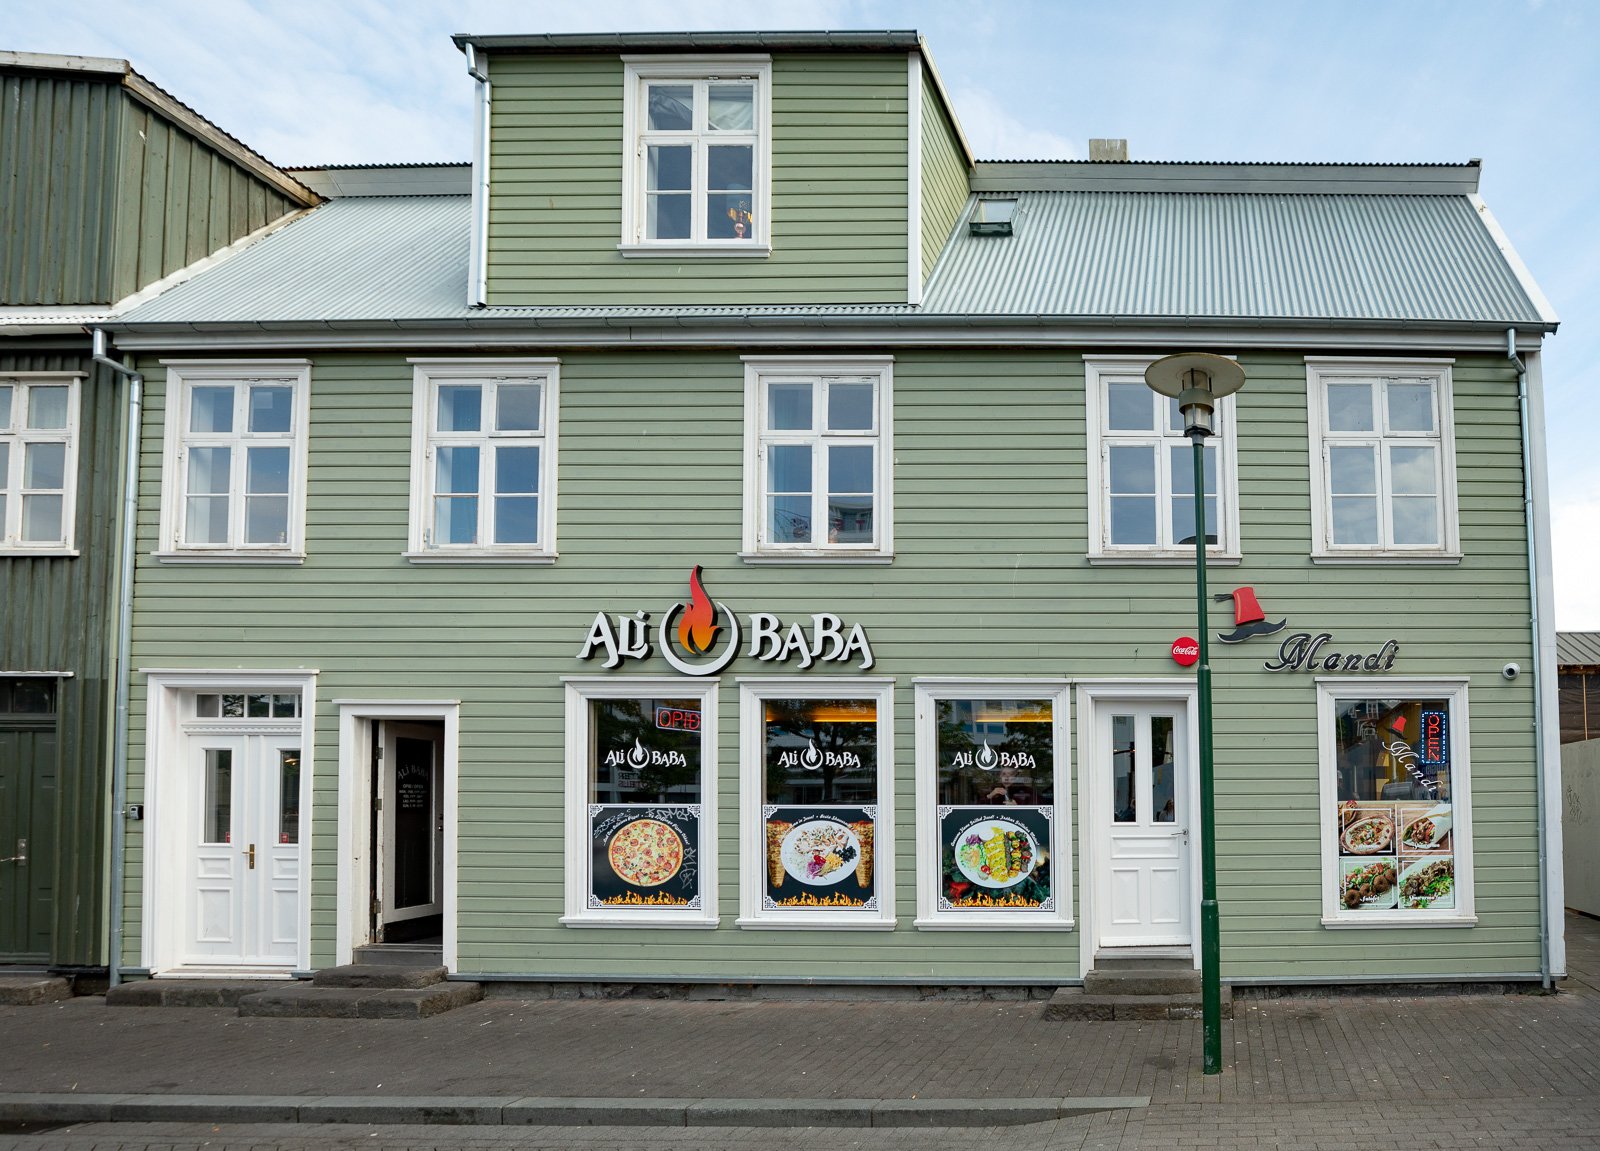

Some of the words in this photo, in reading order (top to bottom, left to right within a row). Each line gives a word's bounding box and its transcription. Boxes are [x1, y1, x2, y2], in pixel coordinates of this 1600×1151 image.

[748, 612, 876, 670] BABA
[1263, 632, 1400, 672] Mandi
[1428, 714, 1440, 761] OPEN
[651, 750, 687, 768] BABA
[825, 751, 861, 768] BABA
[1000, 752, 1036, 769] BABA
[1382, 741, 1443, 792] Mandi
